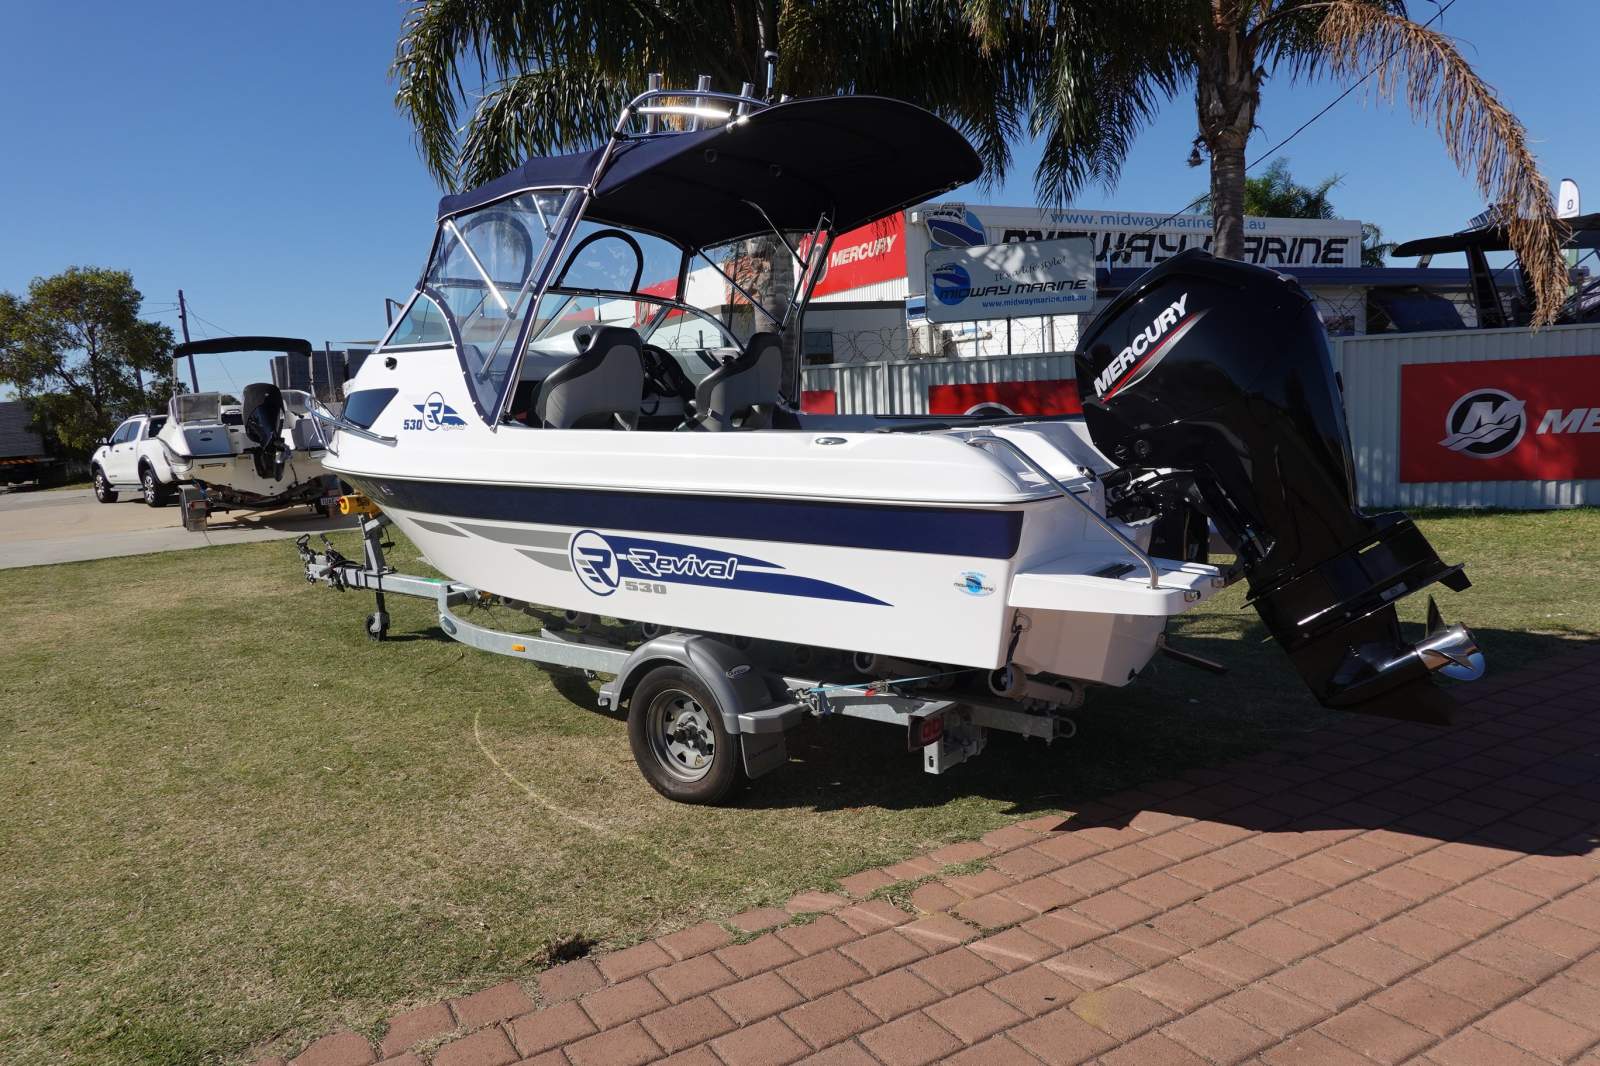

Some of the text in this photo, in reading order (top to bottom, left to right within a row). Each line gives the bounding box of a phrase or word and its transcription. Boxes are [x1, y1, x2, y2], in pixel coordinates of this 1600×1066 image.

[831, 234, 898, 268] MERCURY
[940, 279, 1088, 299] MIDWAY MARINE
[1094, 292, 1188, 398] MERCURY
[403, 419, 423, 430] 530
[626, 547, 738, 580] Revival
[625, 580, 668, 594] 530
